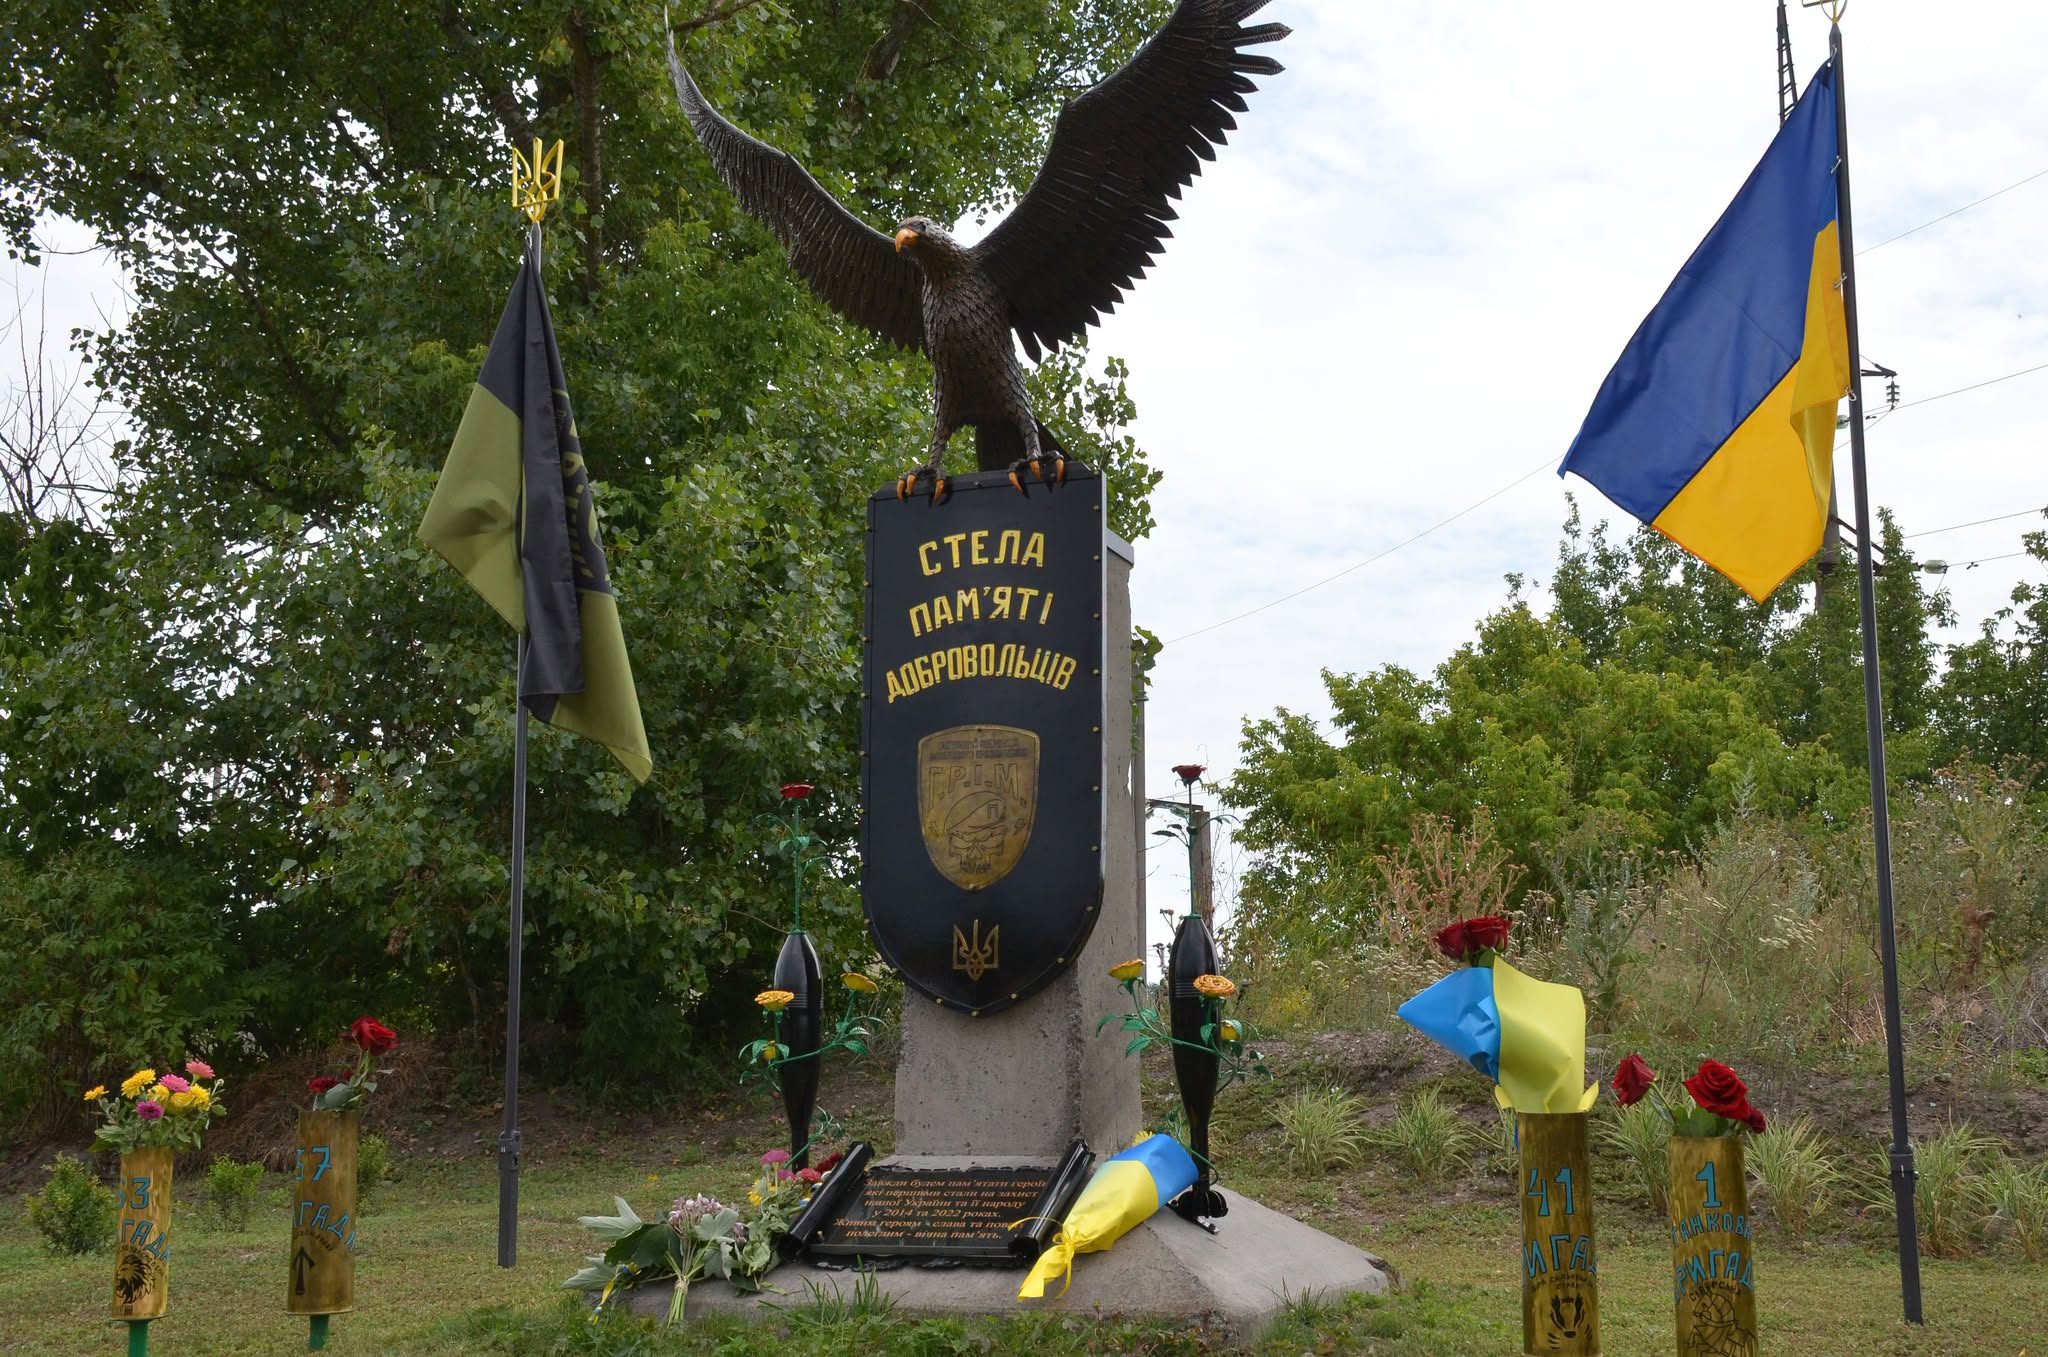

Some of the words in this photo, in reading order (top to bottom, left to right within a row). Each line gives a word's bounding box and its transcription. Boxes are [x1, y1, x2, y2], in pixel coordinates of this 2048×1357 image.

[918, 529, 1045, 576] СТЕЛА
[909, 586, 1054, 637] ПАМ'ЯТІ
[886, 643, 1077, 703] ДОБРОВОЛЬЦІВ
[904, 1199, 952, 1209] України
[1527, 1168, 1574, 1216] 41
[1695, 1161, 1722, 1207] 1
[883, 1209, 914, 1217] 2014
[931, 1209, 962, 1217] 2022
